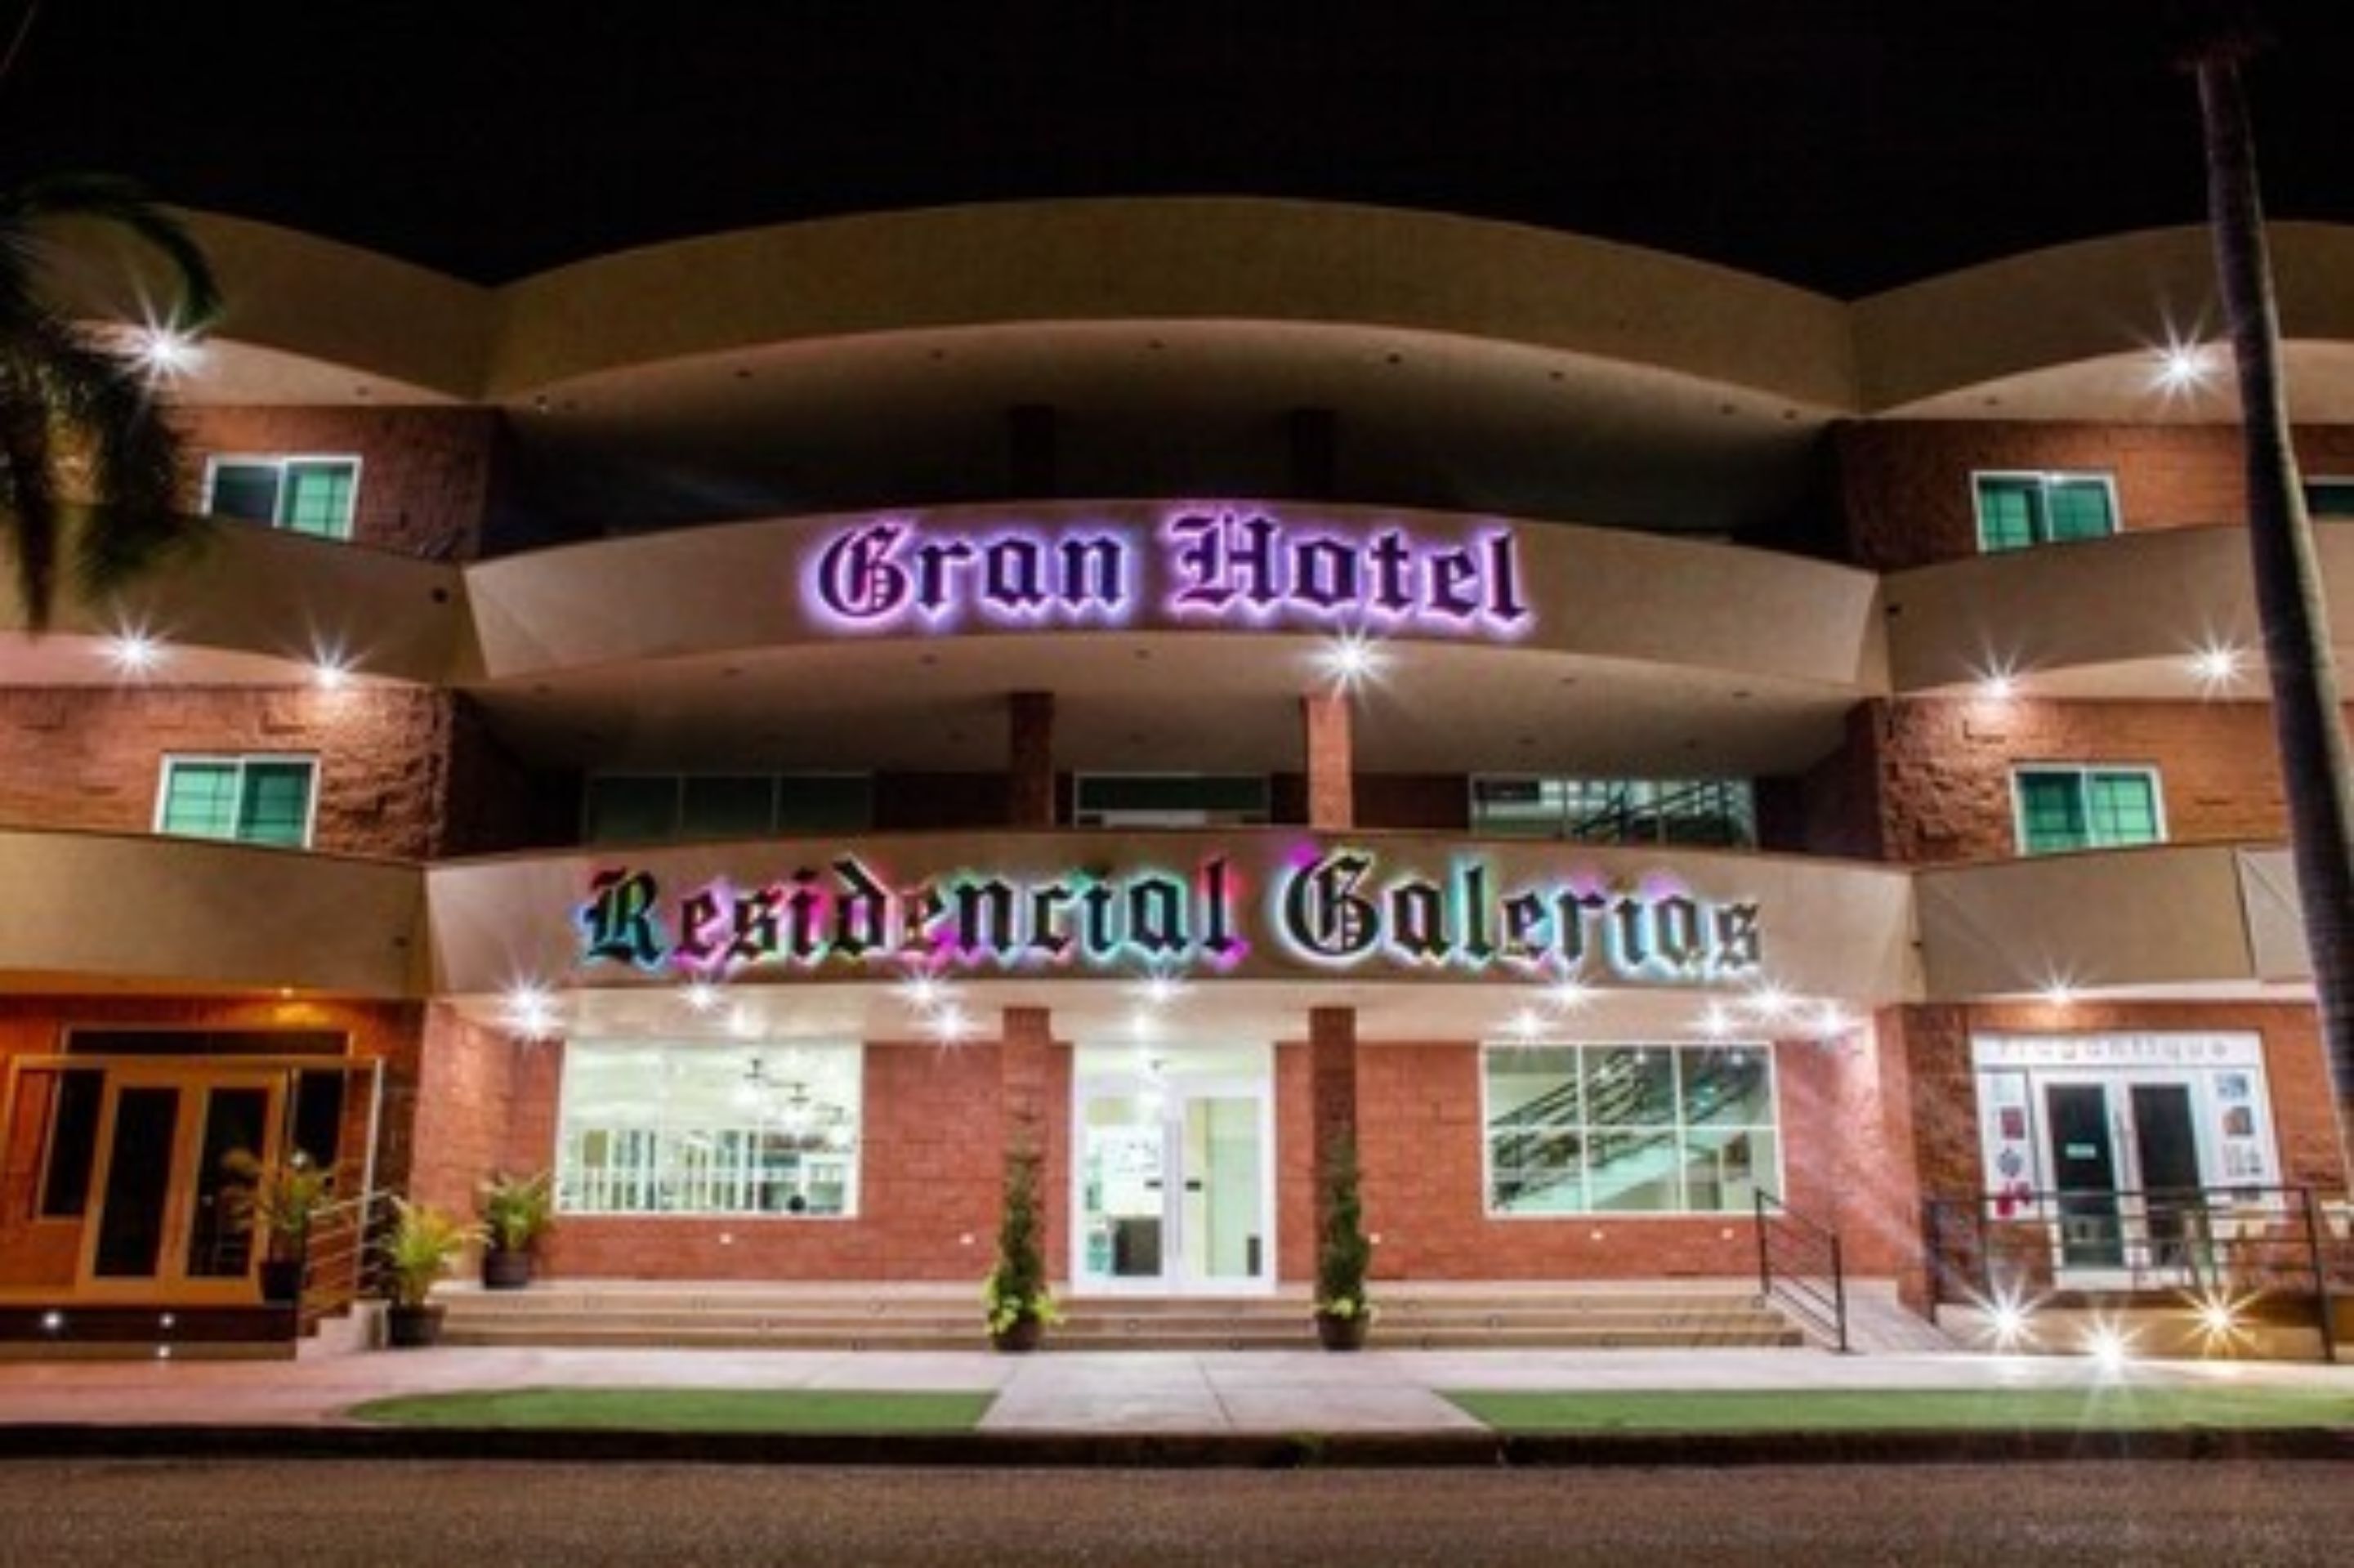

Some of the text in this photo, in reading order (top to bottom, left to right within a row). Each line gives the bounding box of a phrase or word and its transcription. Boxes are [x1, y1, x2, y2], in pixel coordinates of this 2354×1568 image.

[818, 513, 1528, 622] Gran Hotel
[583, 852, 1762, 971] Residencial Galerias
